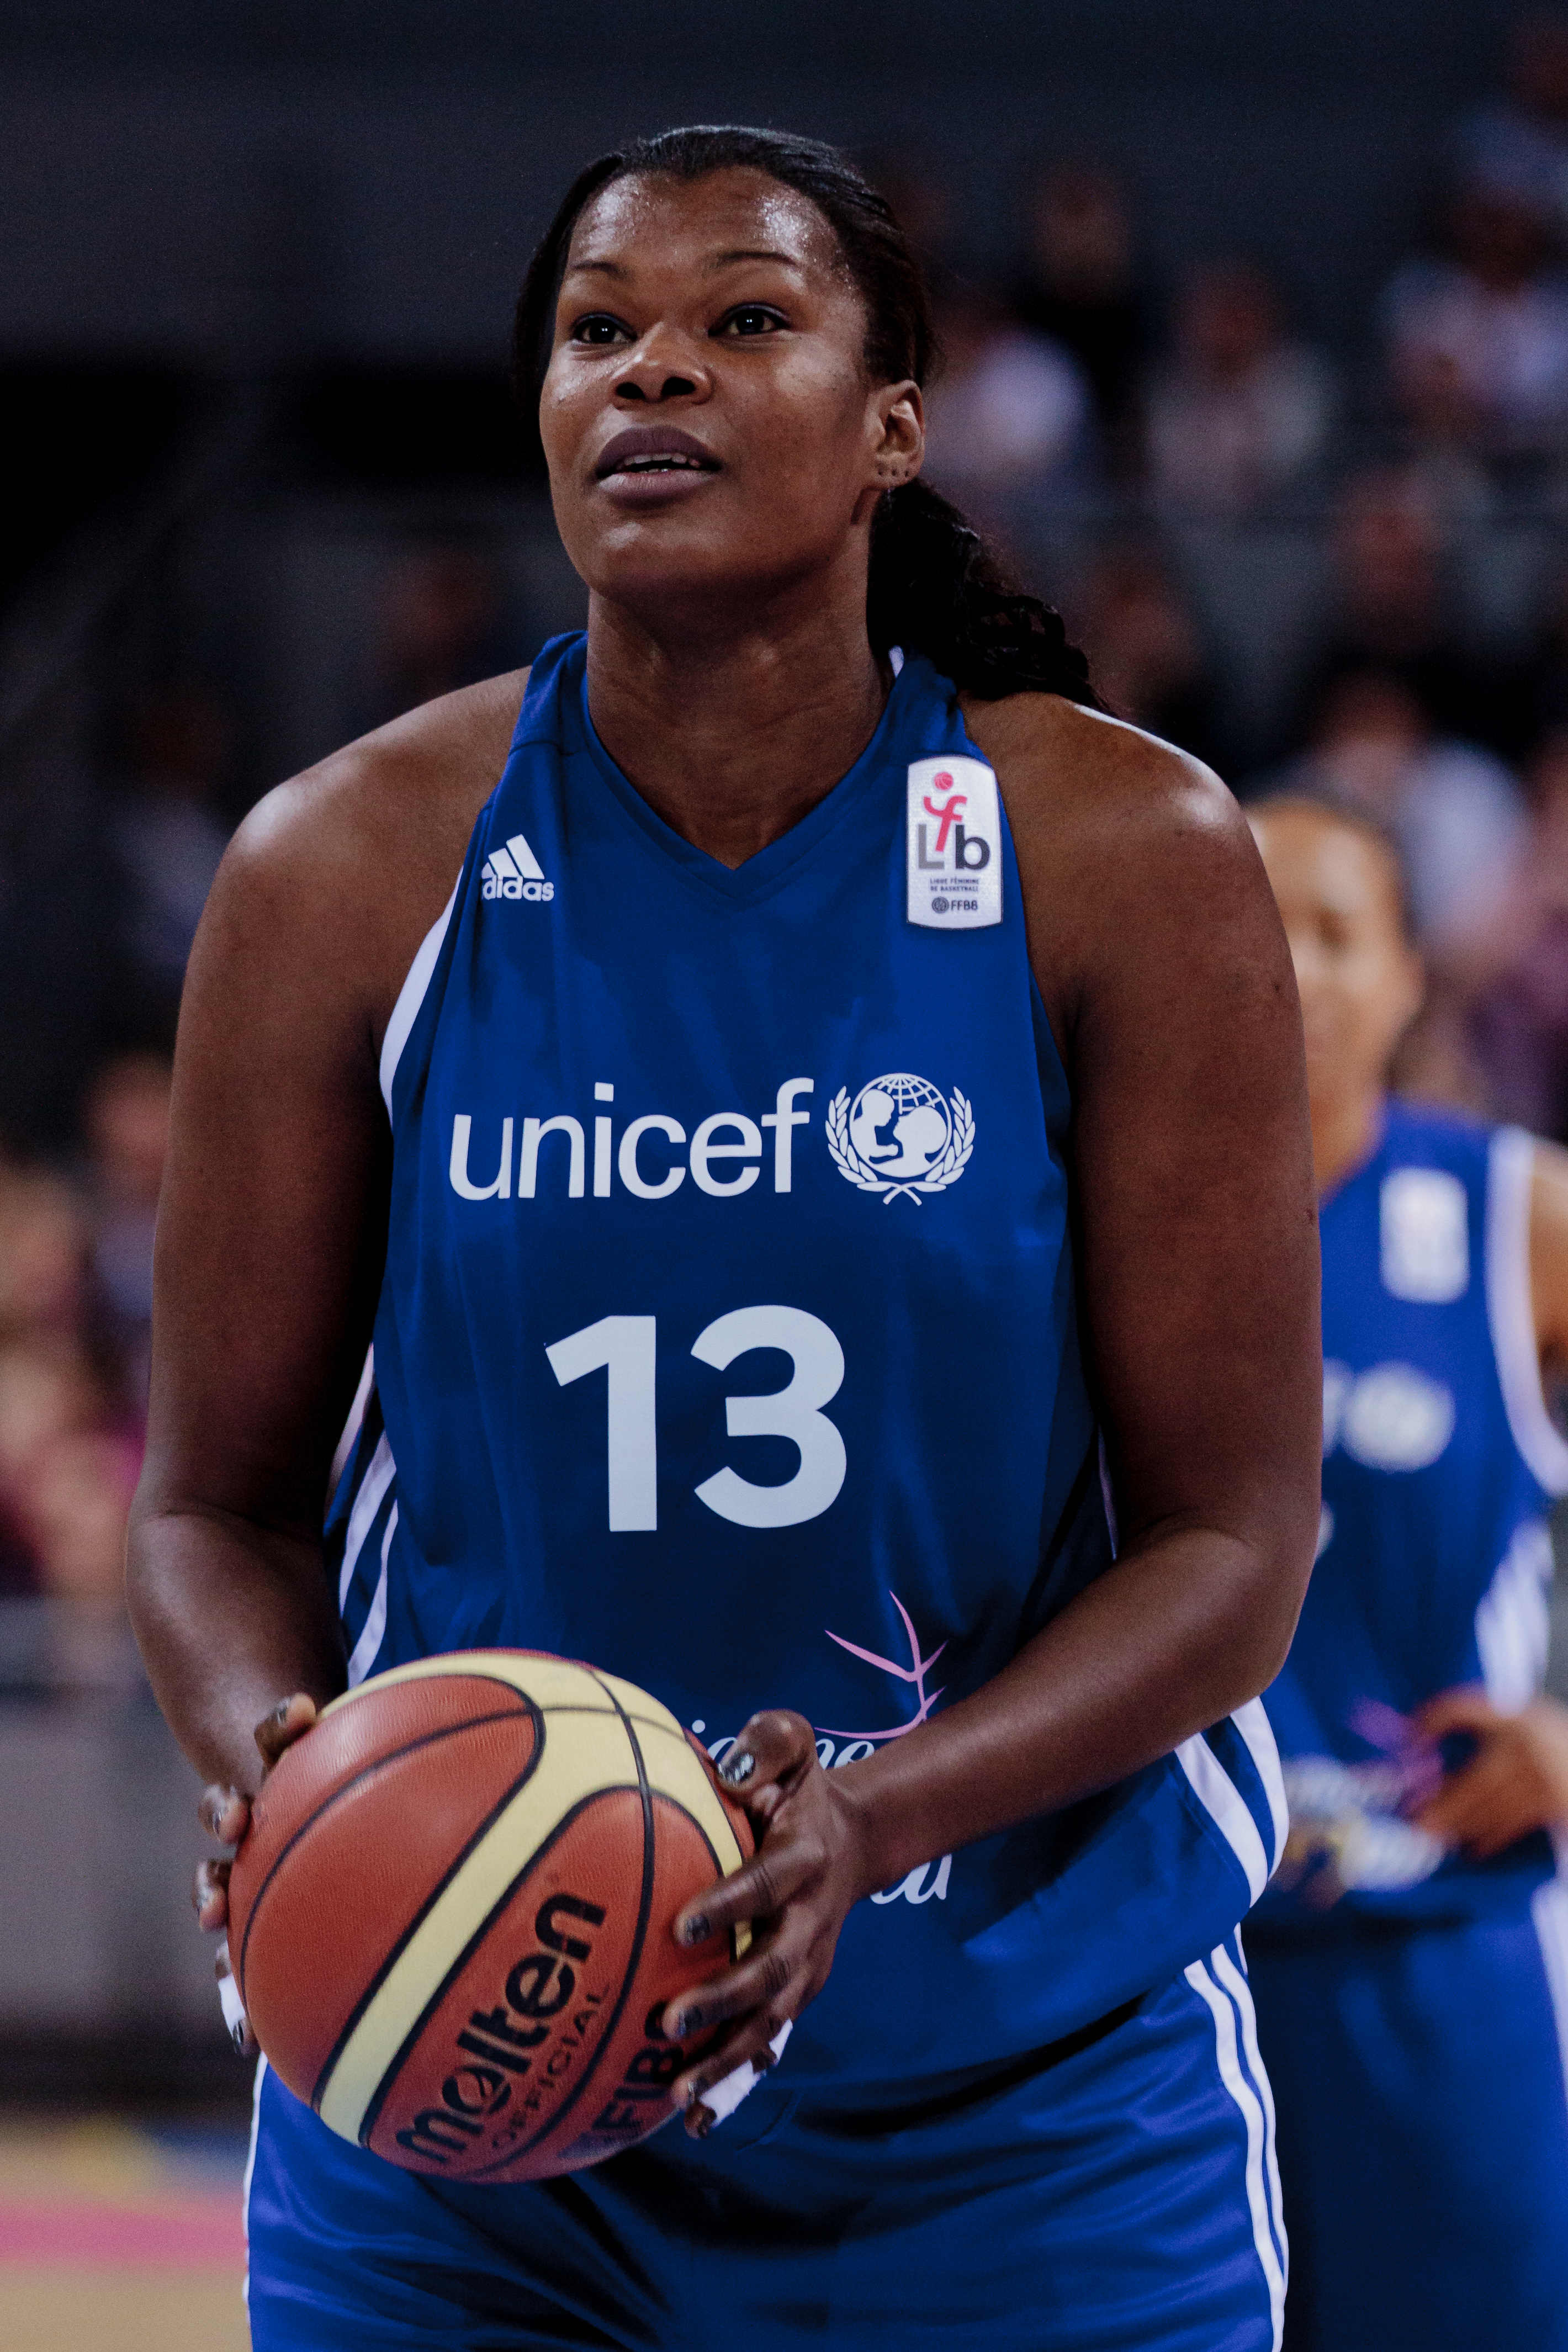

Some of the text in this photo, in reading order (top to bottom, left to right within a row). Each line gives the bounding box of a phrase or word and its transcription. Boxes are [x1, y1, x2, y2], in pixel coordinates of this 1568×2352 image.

[482, 874, 554, 901] didas
[951, 899, 978, 911] FFBB
[449, 1077, 814, 1200] unicef
[545, 1305, 846, 1532] 13
[396, 1893, 606, 2163] molten
[492, 1984, 610, 2149] OFFICIAL
